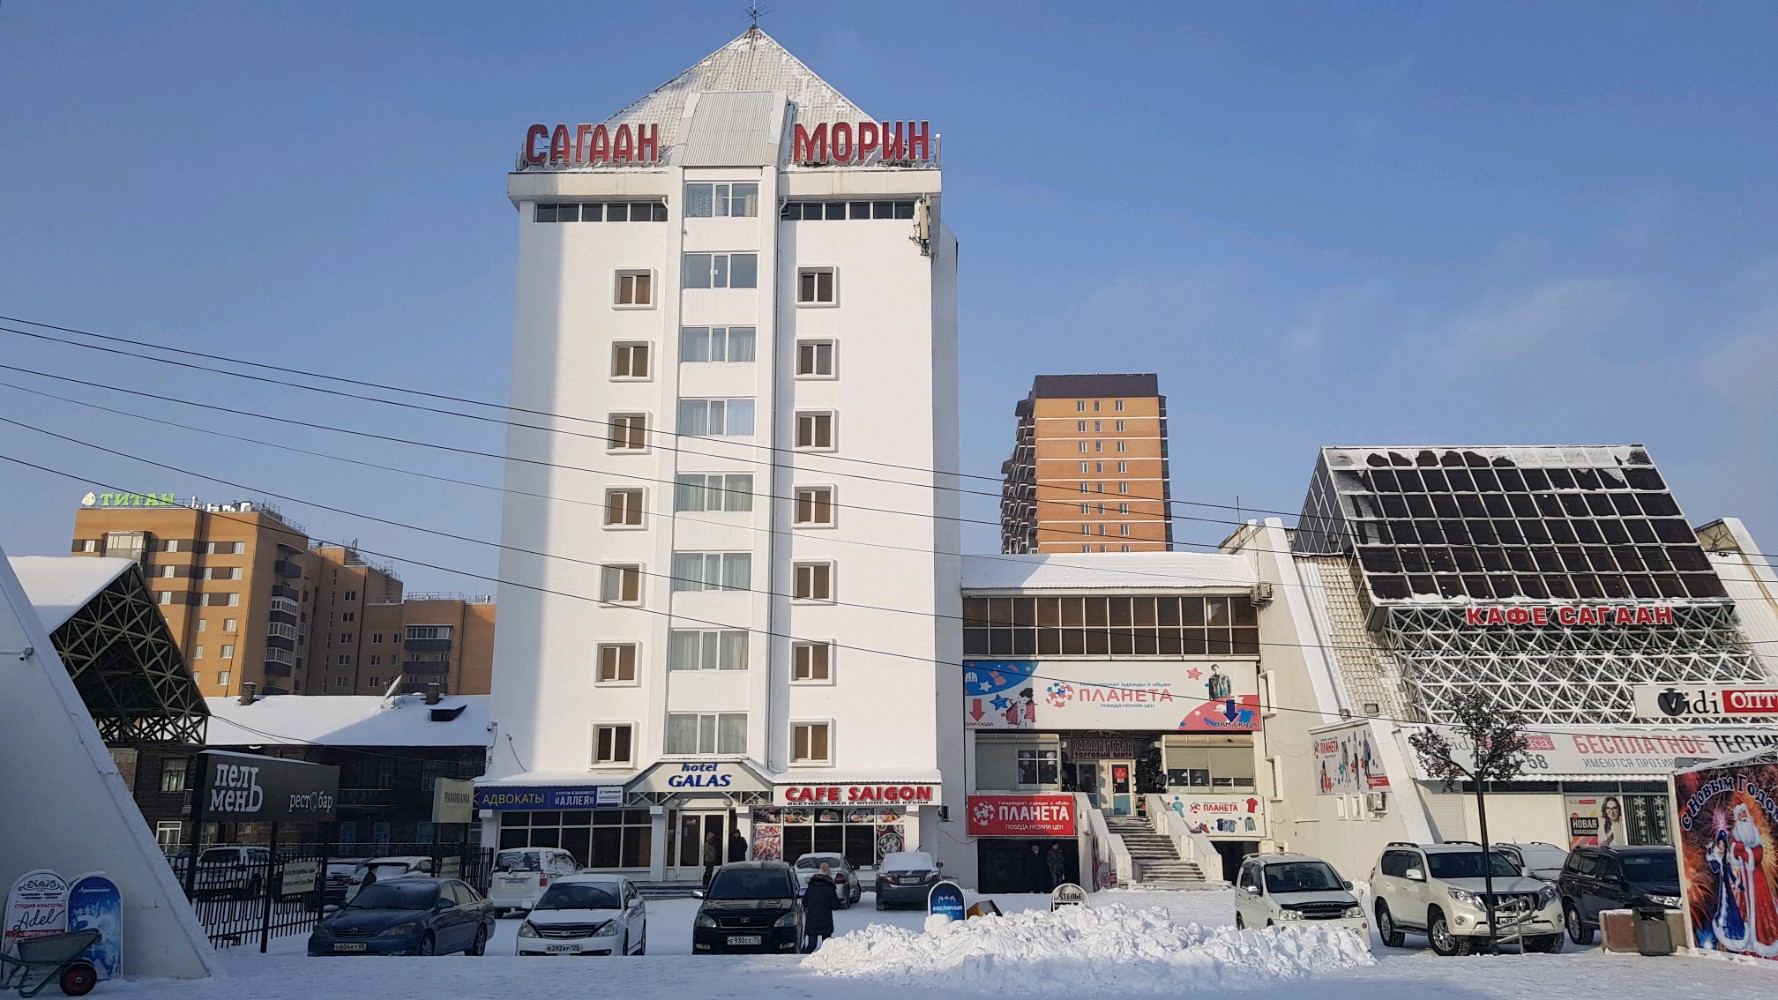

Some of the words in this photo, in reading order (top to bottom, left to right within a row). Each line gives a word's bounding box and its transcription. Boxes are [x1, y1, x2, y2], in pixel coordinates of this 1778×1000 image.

[526, 123, 659, 164] САГААН
[794, 120, 930, 164] МОРИН
[100, 493, 175, 506] ТИТАН
[1466, 607, 1548, 625] КАФЕ
[1559, 606, 1673, 625] САГААН
[1079, 688, 1173, 702] ПЛАНЕТА
[1659, 689, 1720, 715] Vidi
[1572, 735, 1710, 754] БЕСПЛАТНОЕ
[681, 762, 718, 771] hotel
[1582, 758, 1634, 767] ИМЕЮТСЯ
[668, 774, 732, 787] GALAS
[482, 793, 545, 806] АДВОКАТЫ
[785, 787, 842, 801] CAFE
[848, 786, 933, 801] SAIGON
[998, 806, 1070, 821] ПЛАНЕТА
[1203, 803, 1239, 812] ПЛАНЕТА
[1573, 819, 1597, 828] НОВАЯ
[13, 908, 65, 931] Adel
